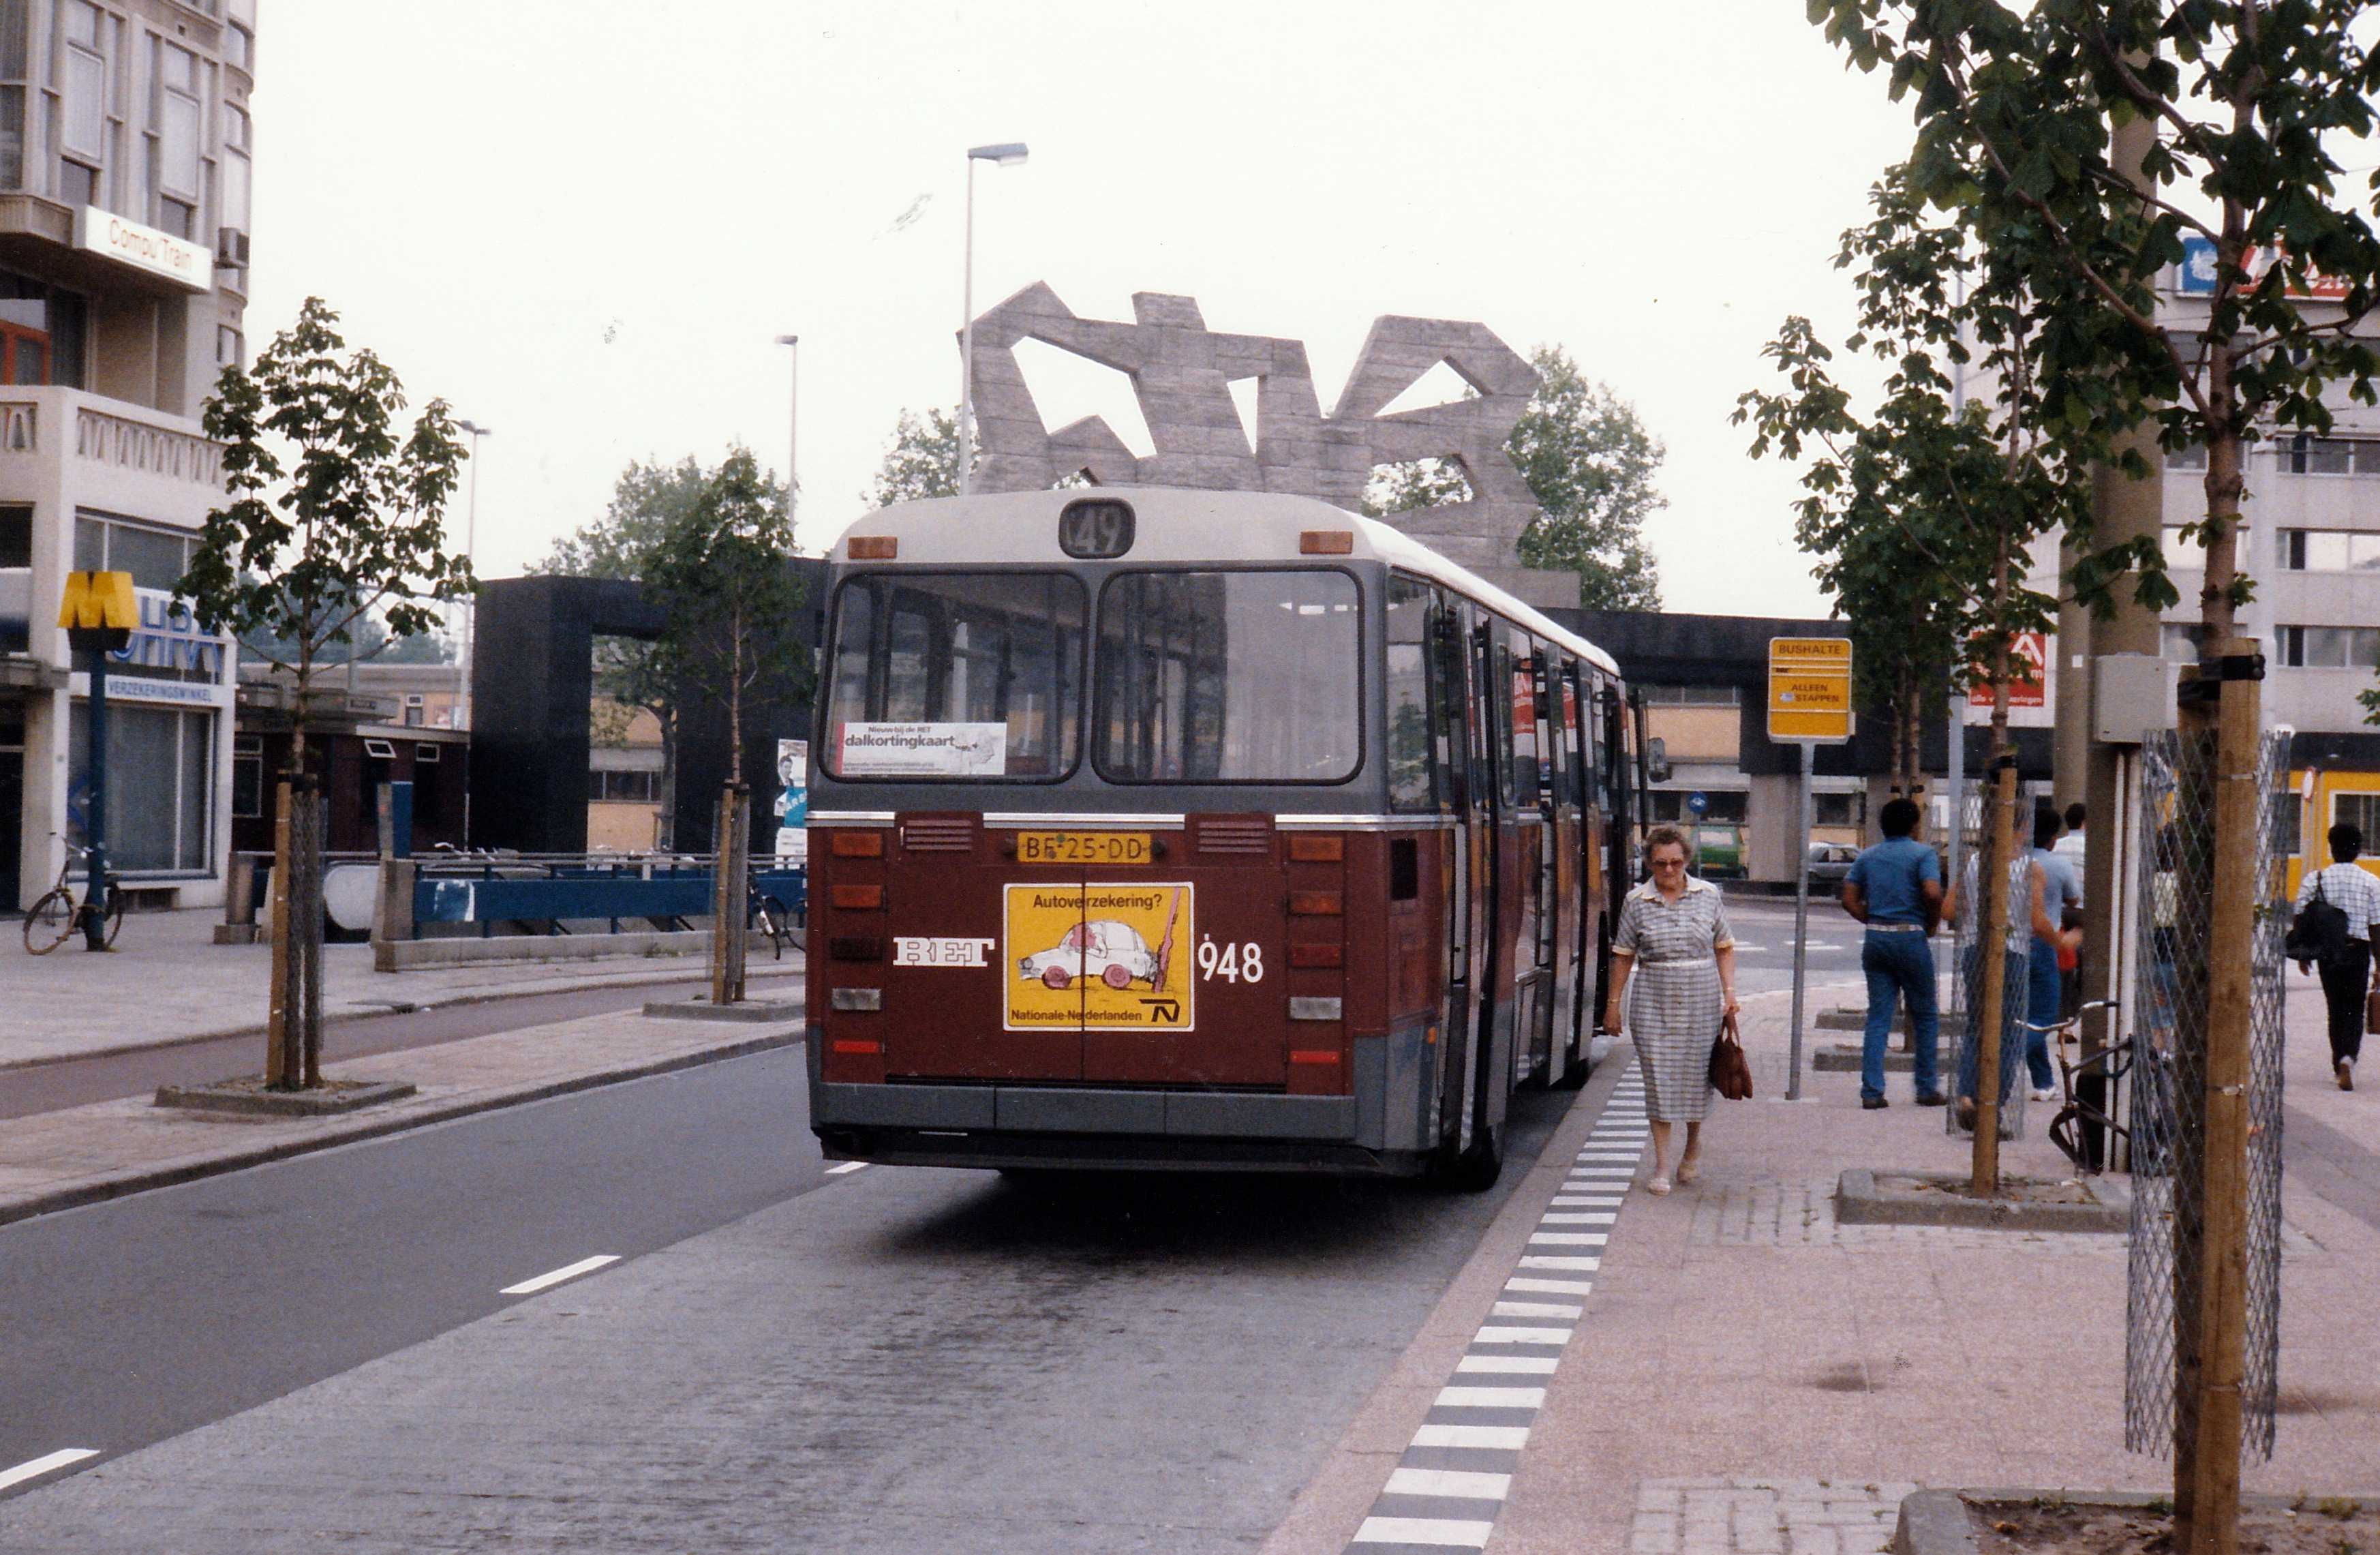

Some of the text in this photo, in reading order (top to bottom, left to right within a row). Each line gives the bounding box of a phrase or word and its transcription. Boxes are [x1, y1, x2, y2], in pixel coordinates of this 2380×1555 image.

[57, 571, 140, 629] M
[1779, 645, 1841, 654] BUSHALTE
[108, 681, 212, 701] VERZEKERINGSWINKEL
[1791, 684, 1828, 692] ALLEEN
[894, 726, 904, 735] bij
[844, 734, 956, 750] dalkortingkaart
[1033, 894, 1163, 911] Autoverzekering?
[893, 937, 995, 967] RET
[1197, 941, 1264, 983] 948
[1011, 1010, 1142, 1021] Nationale-Nederlanden
